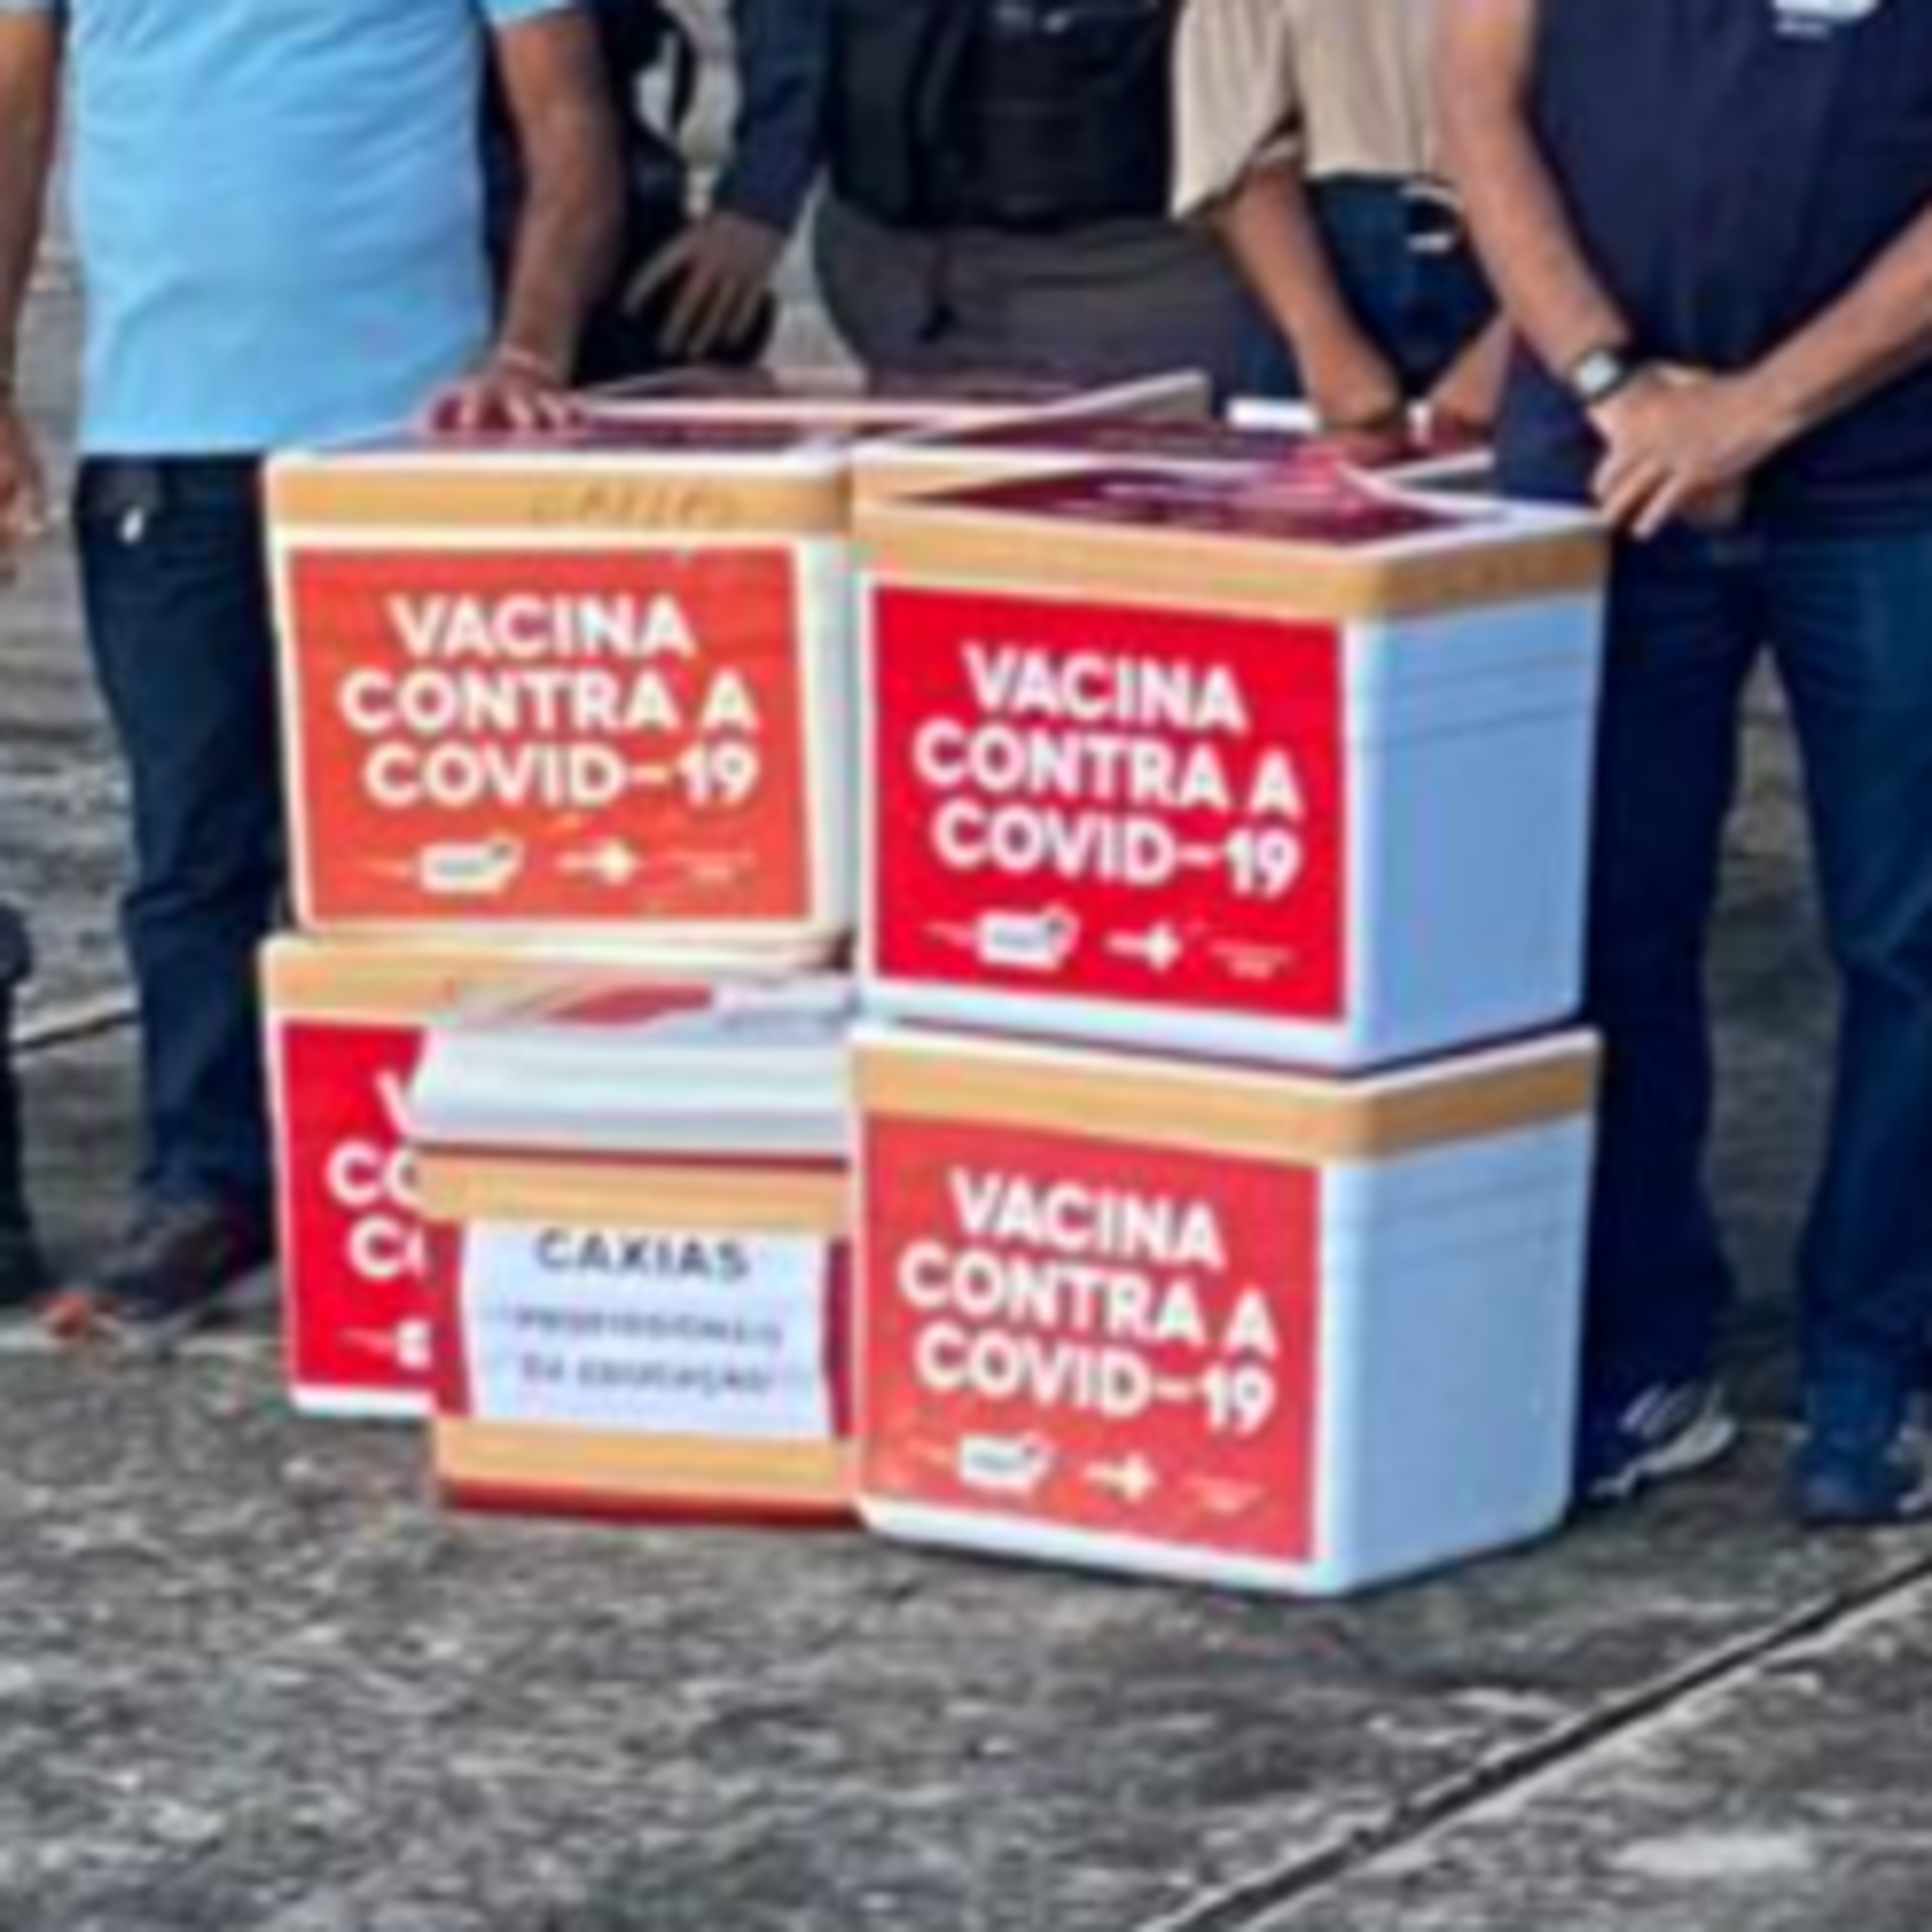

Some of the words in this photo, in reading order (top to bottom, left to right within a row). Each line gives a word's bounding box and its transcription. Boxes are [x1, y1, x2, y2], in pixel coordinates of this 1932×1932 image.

[390, 594, 696, 660] VACINA
[337, 667, 680, 735] CONTRA
[699, 670, 757, 731] A
[963, 644, 1247, 733] VACINA
[363, 740, 759, 808] COVID-19
[913, 717, 1232, 811] CONTRA
[1247, 750, 1302, 819] A
[932, 797, 1302, 896] COVID-19
[535, 1227, 751, 1284] CAXIAS
[950, 1168, 1224, 1269] VACINA
[897, 1240, 1206, 1345] CONTRA
[1224, 1289, 1277, 1356] A
[914, 1320, 1276, 1433] COVID-19
